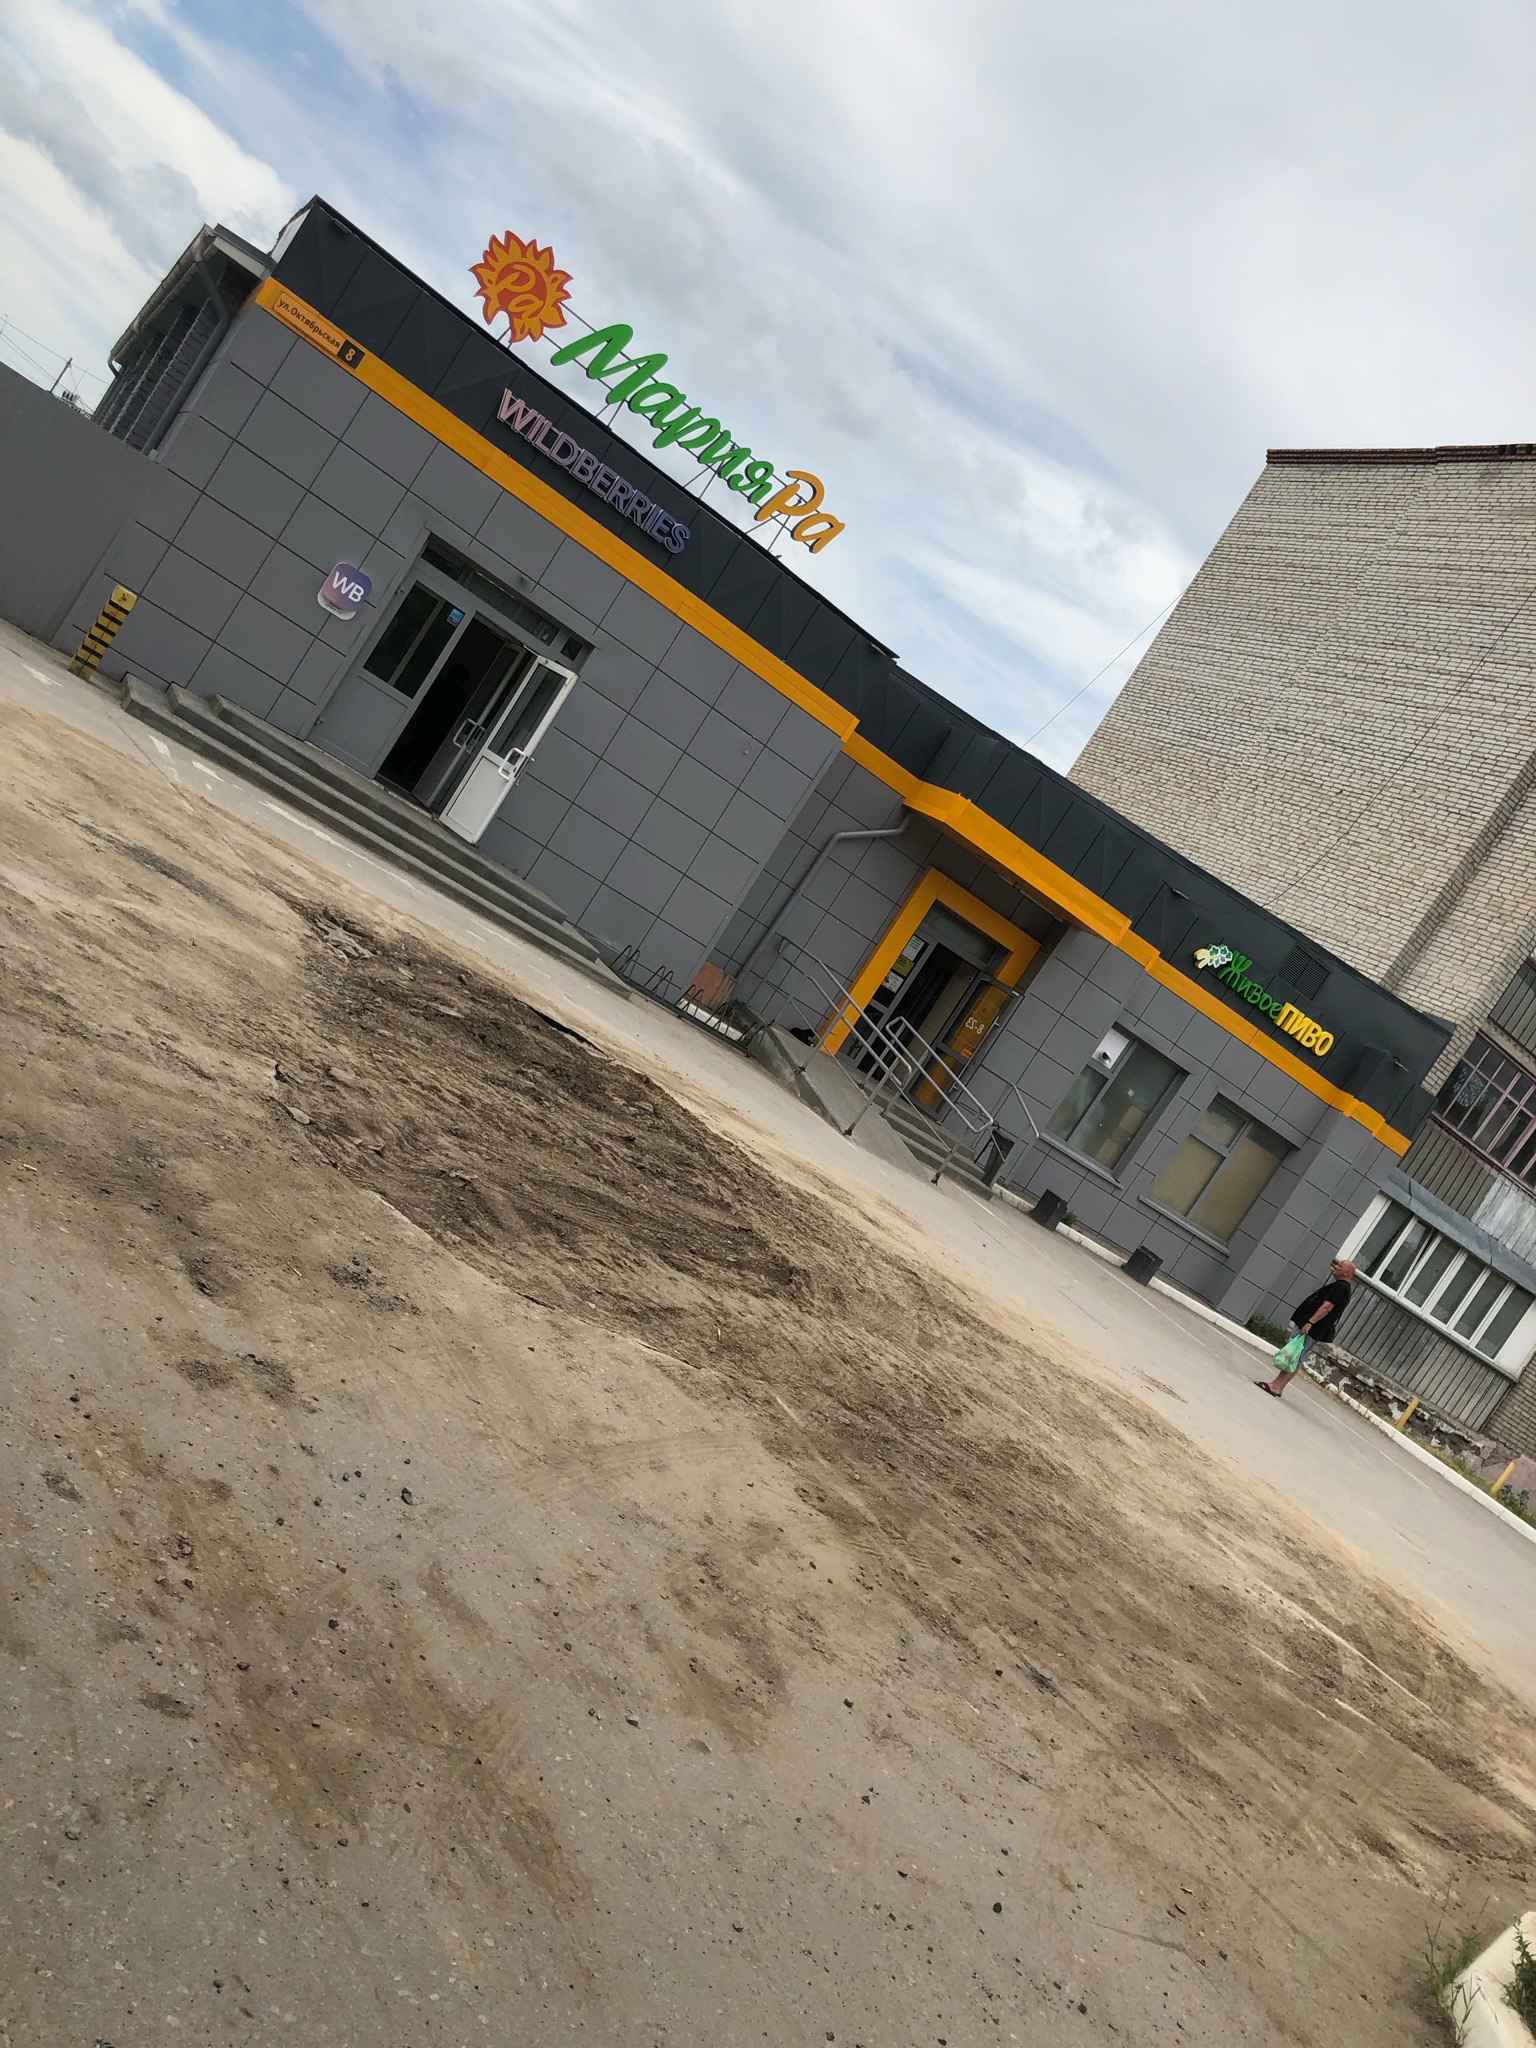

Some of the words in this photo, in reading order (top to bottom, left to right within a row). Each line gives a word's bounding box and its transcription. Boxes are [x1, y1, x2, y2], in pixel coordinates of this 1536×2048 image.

[345, 349, 355, 361] 8
[496, 388, 691, 554] WILDBERRIES
[550, 324, 774, 503] Мария
[754, 470, 845, 553] Ра
[332, 571, 364, 602] WB
[1218, 950, 1283, 1019] Живое
[1274, 1002, 1334, 1056] ПИВО
